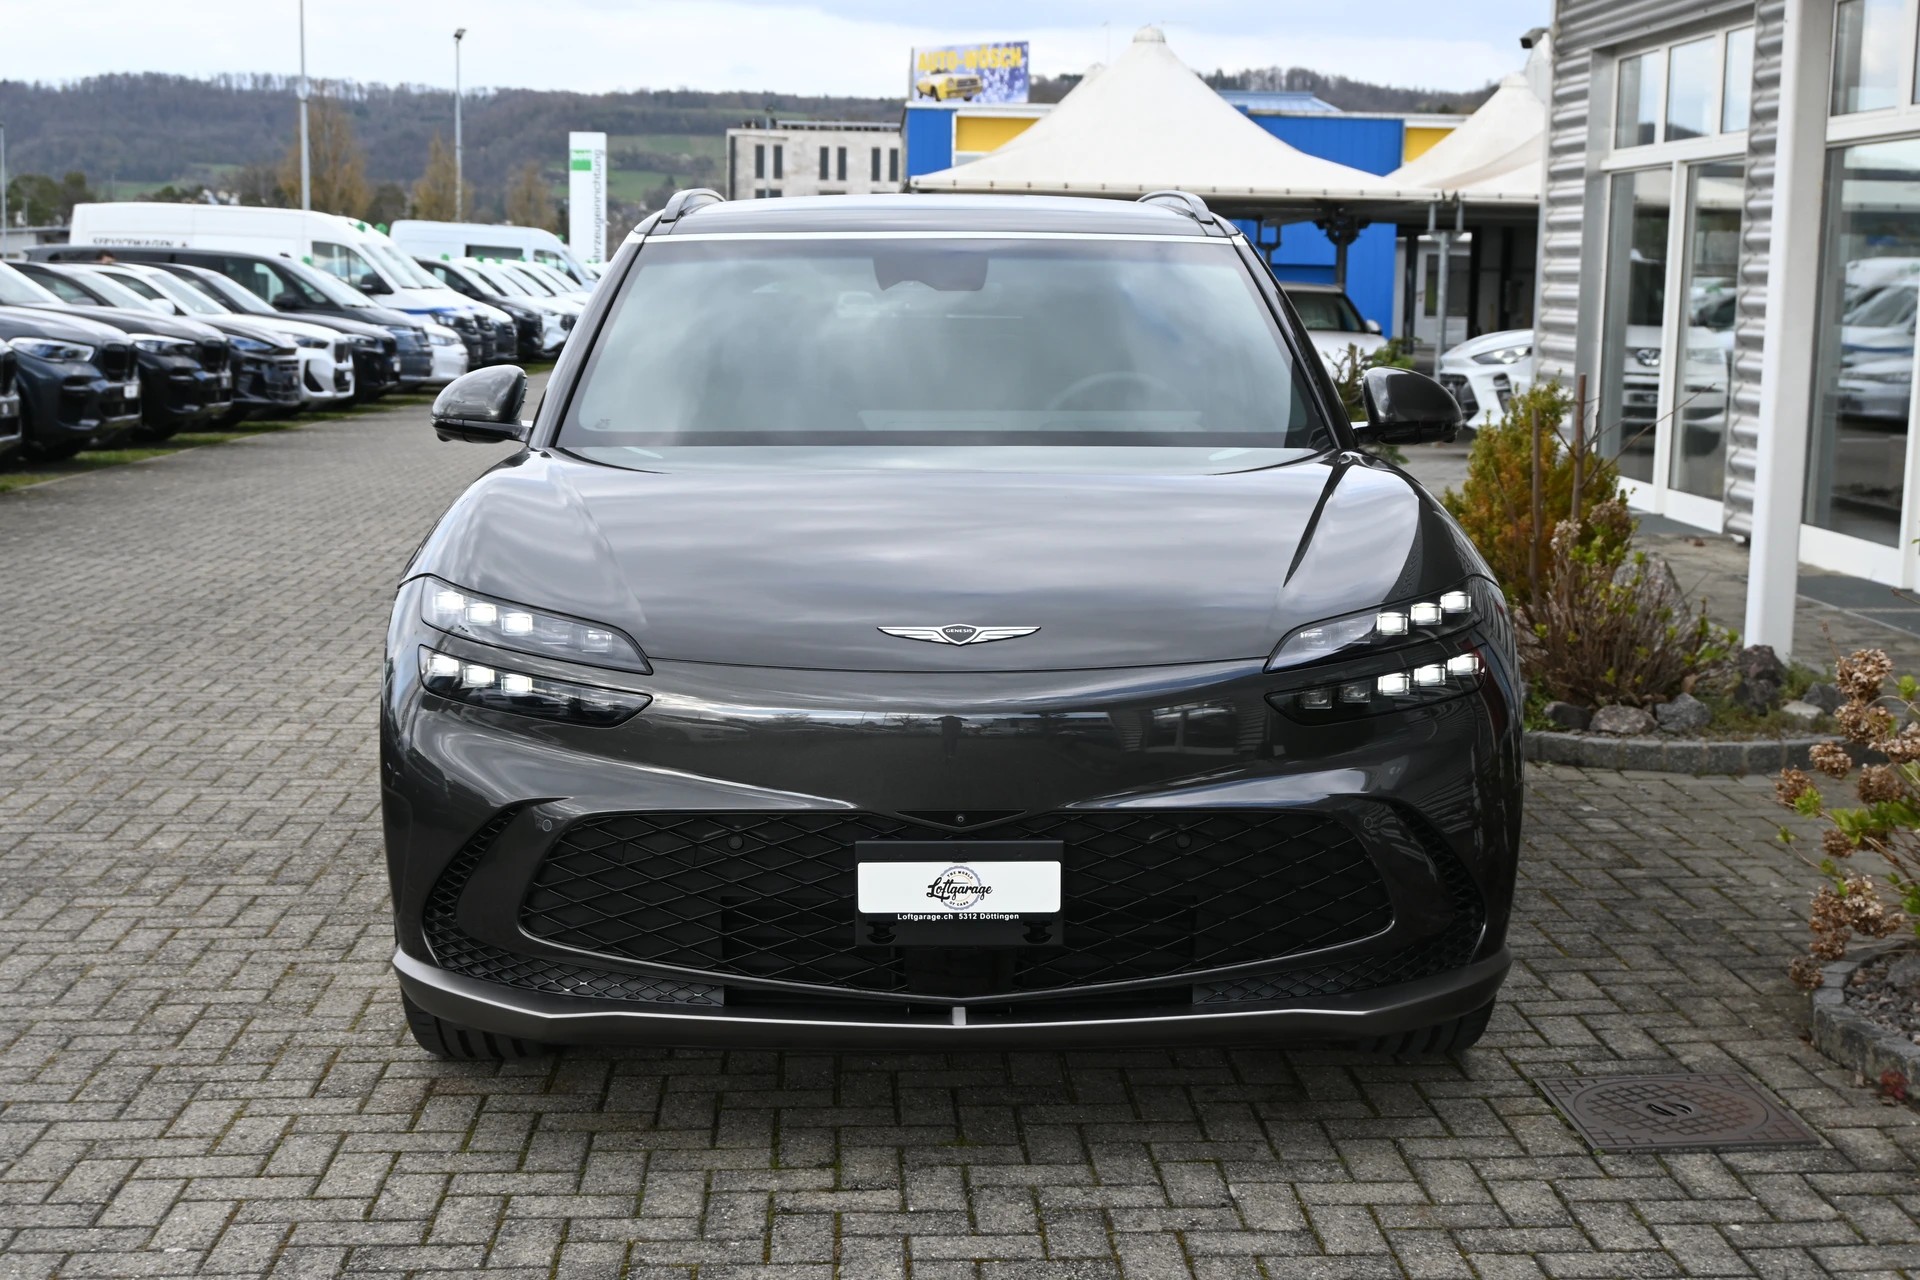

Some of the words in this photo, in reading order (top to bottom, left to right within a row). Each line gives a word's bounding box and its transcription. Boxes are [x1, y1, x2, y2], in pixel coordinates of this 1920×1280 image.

[958, 870, 974, 880] WORLD
[926, 876, 993, 902] Loftgarage
[897, 913, 953, 921] Loftgarage.ch
[958, 912, 977, 920] 5312
[980, 912, 1019, 921] Döttingen
